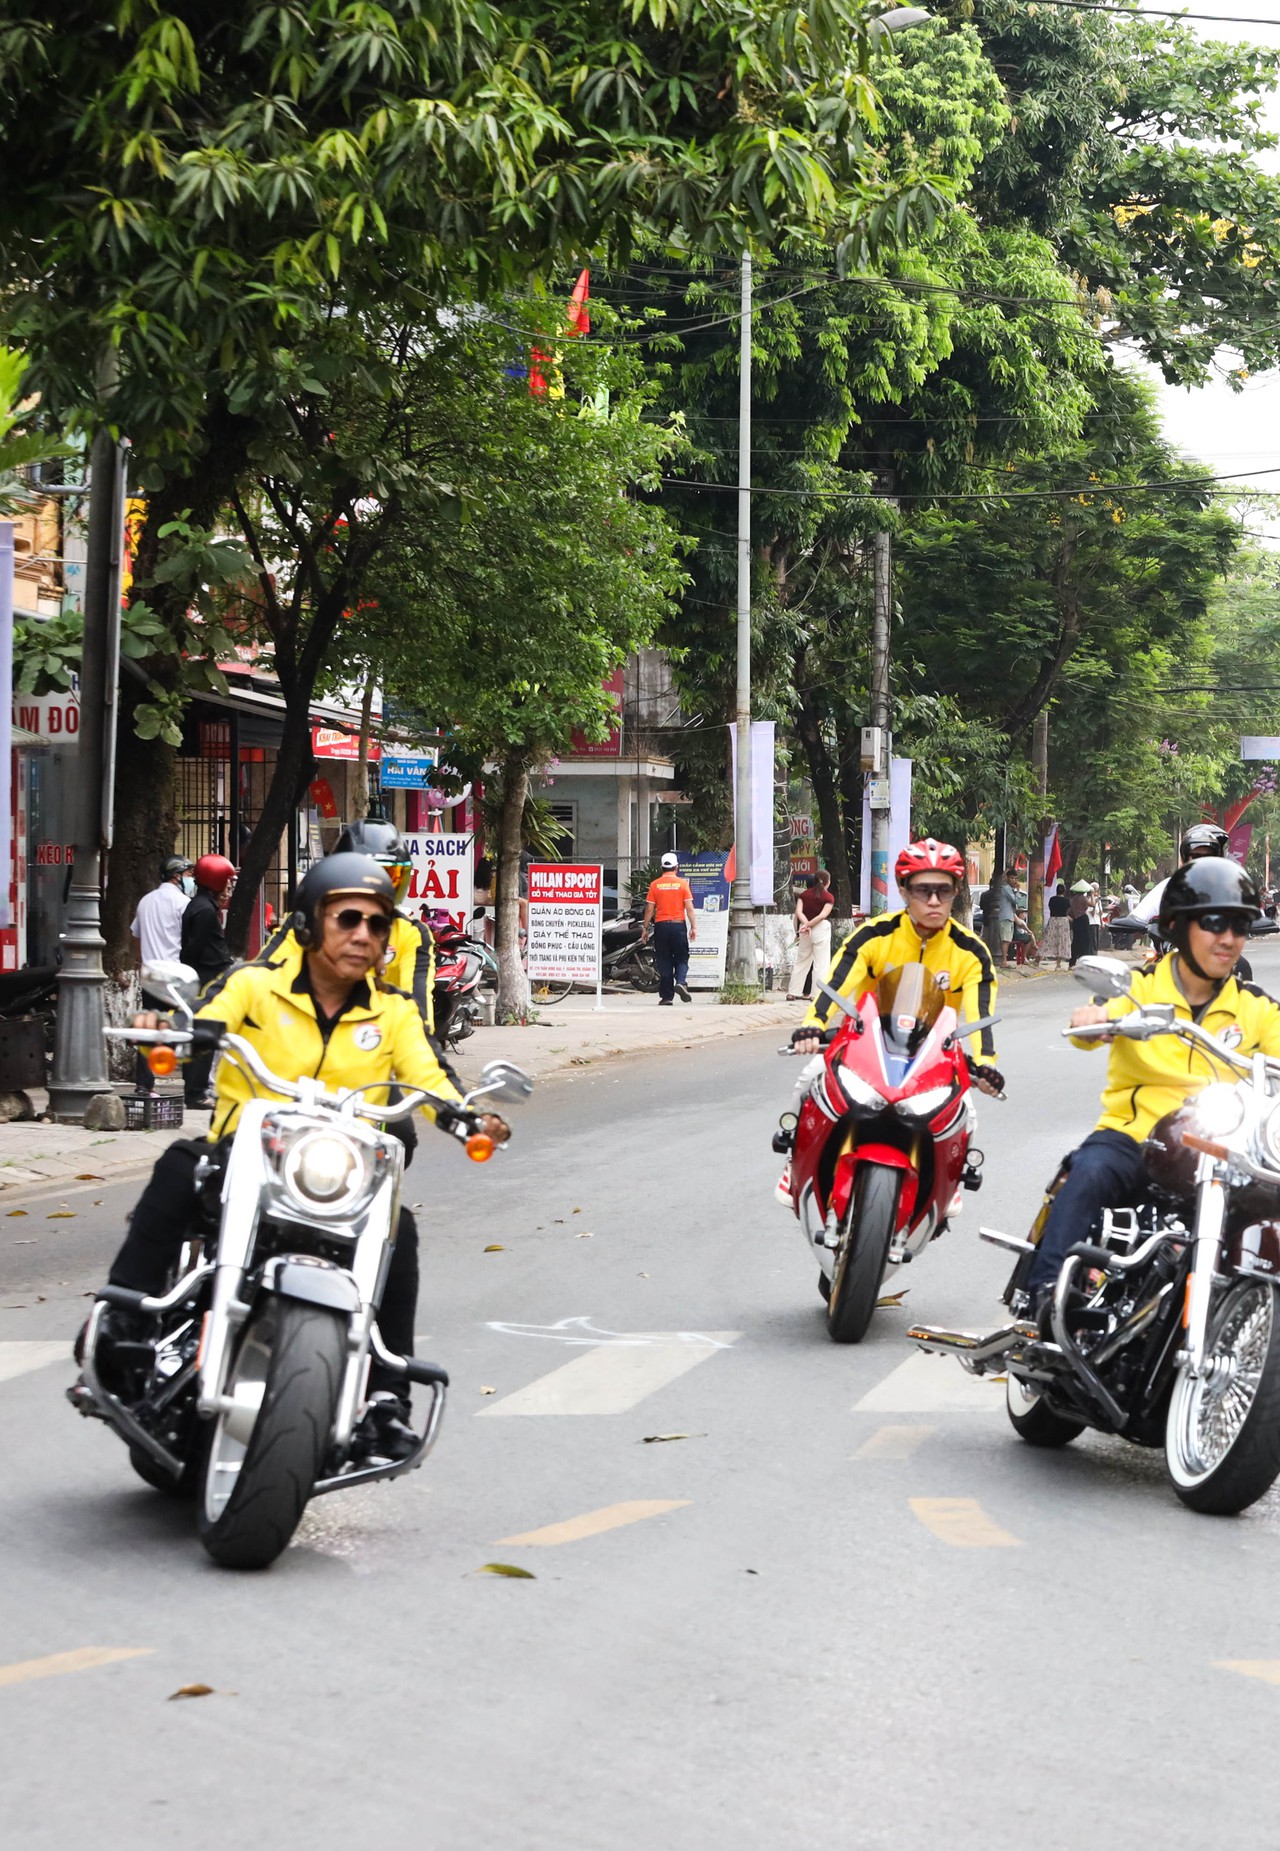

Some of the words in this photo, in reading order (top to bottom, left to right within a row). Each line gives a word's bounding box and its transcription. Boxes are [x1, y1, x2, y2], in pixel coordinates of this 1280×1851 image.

[531, 872, 563, 888] MILAN
[564, 872, 598, 888] SPORT
[568, 920, 595, 928] PICKLEBALL
[572, 931, 593, 939] THAO
